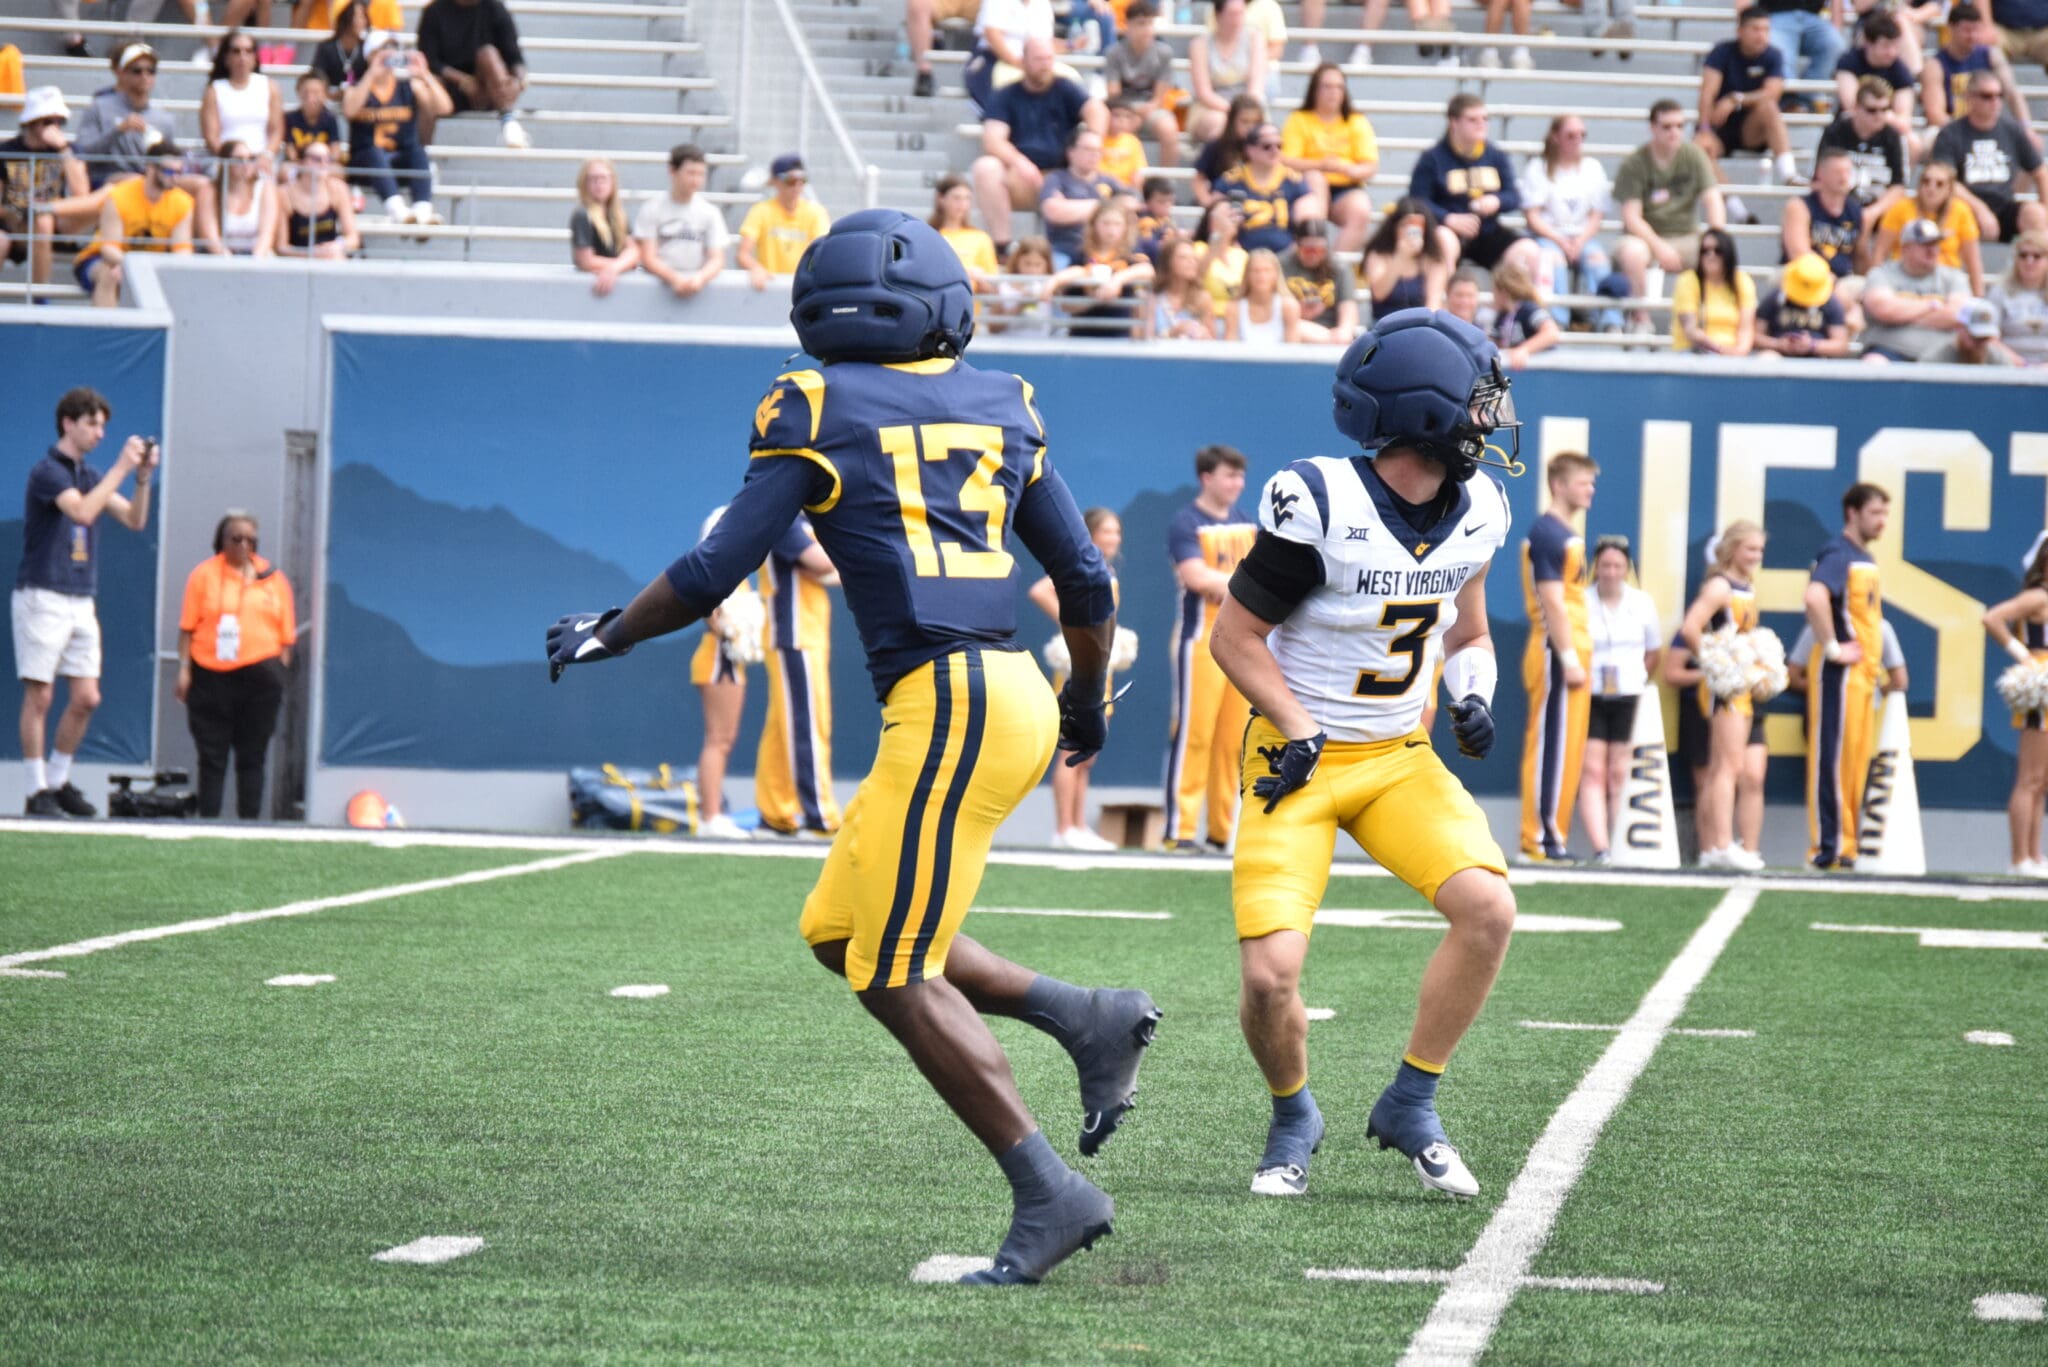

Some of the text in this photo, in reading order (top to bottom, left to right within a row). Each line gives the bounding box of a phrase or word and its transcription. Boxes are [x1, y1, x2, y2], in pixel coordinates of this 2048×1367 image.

[878, 422, 1015, 579] 13
[1356, 566, 1469, 596] WEST VIRGINIA
[1352, 598, 1444, 699] 3
[1626, 742, 1664, 850] WVU
